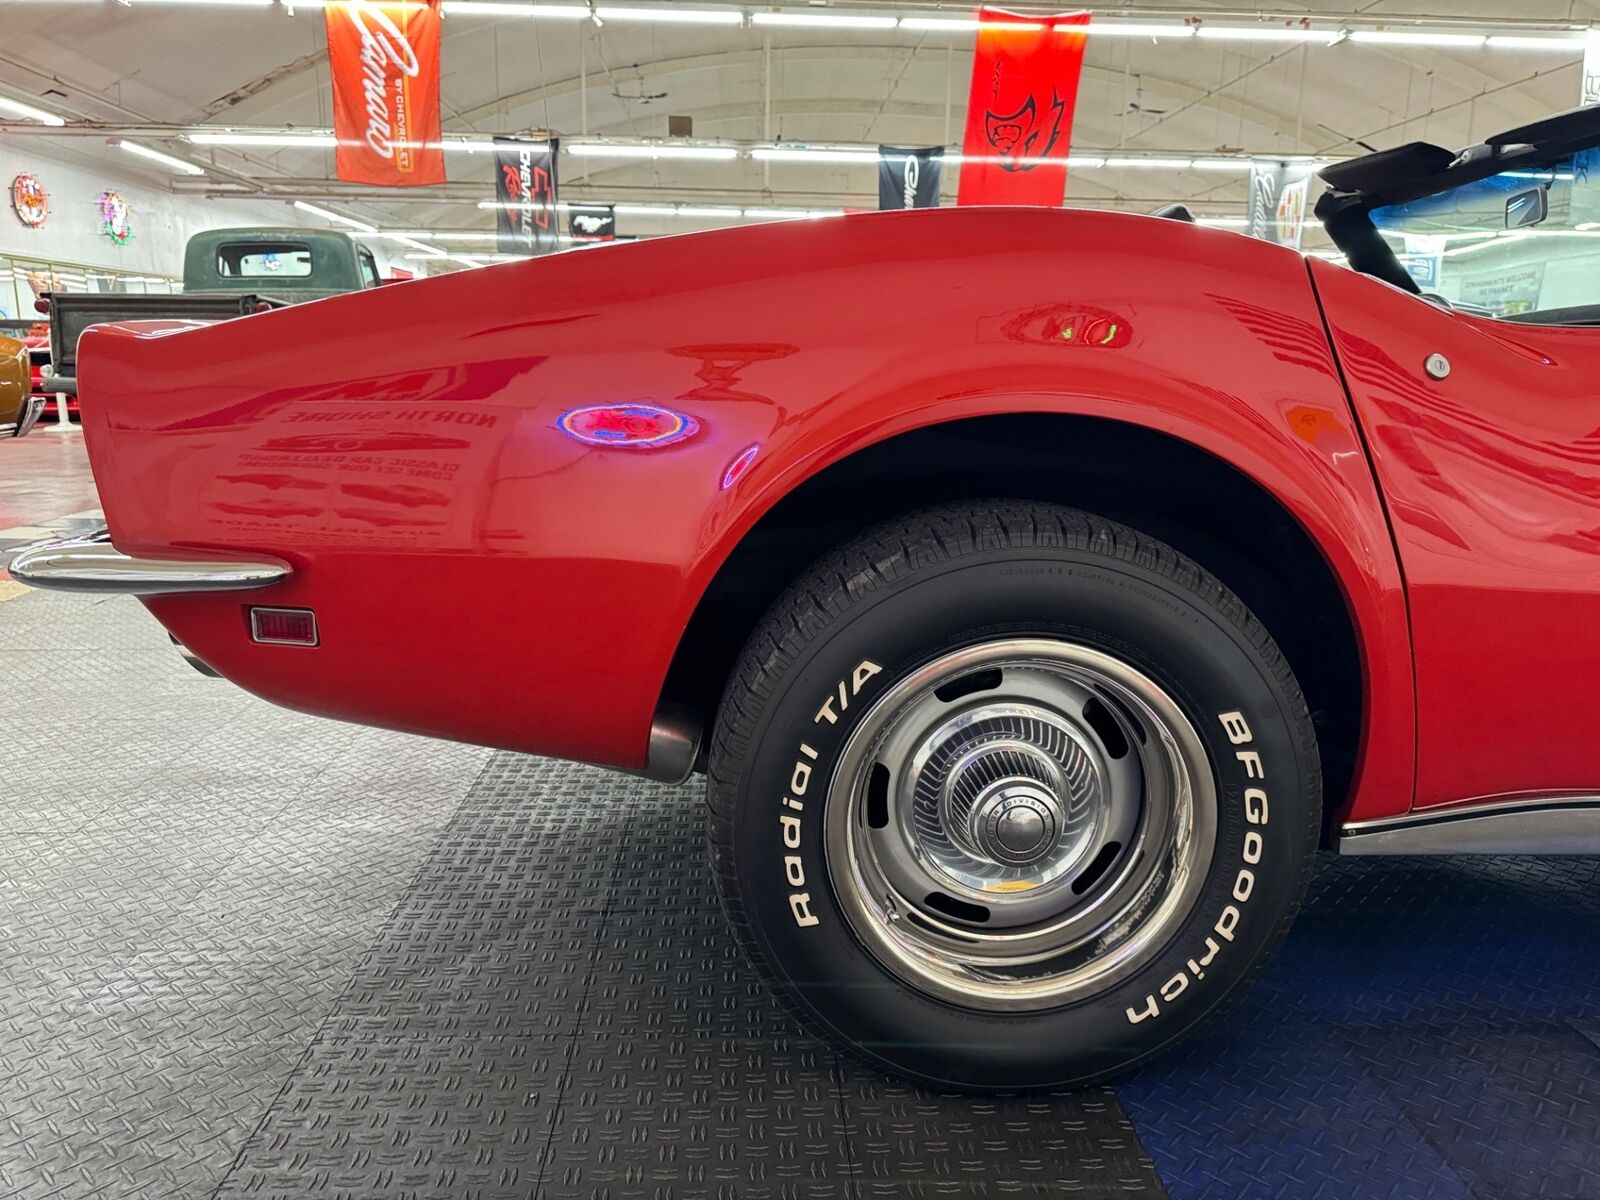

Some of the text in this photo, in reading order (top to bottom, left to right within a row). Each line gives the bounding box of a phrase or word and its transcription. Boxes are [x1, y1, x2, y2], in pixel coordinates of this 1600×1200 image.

[347, 2, 420, 159] Camaro
[394, 78, 409, 167] BY CHEVROLET
[519, 149, 532, 249] CHEVROLET
[779, 660, 883, 927] Radial T/A
[1006, 798, 1052, 821] DIVISION
[1125, 711, 1268, 1024] BFGoodrich
